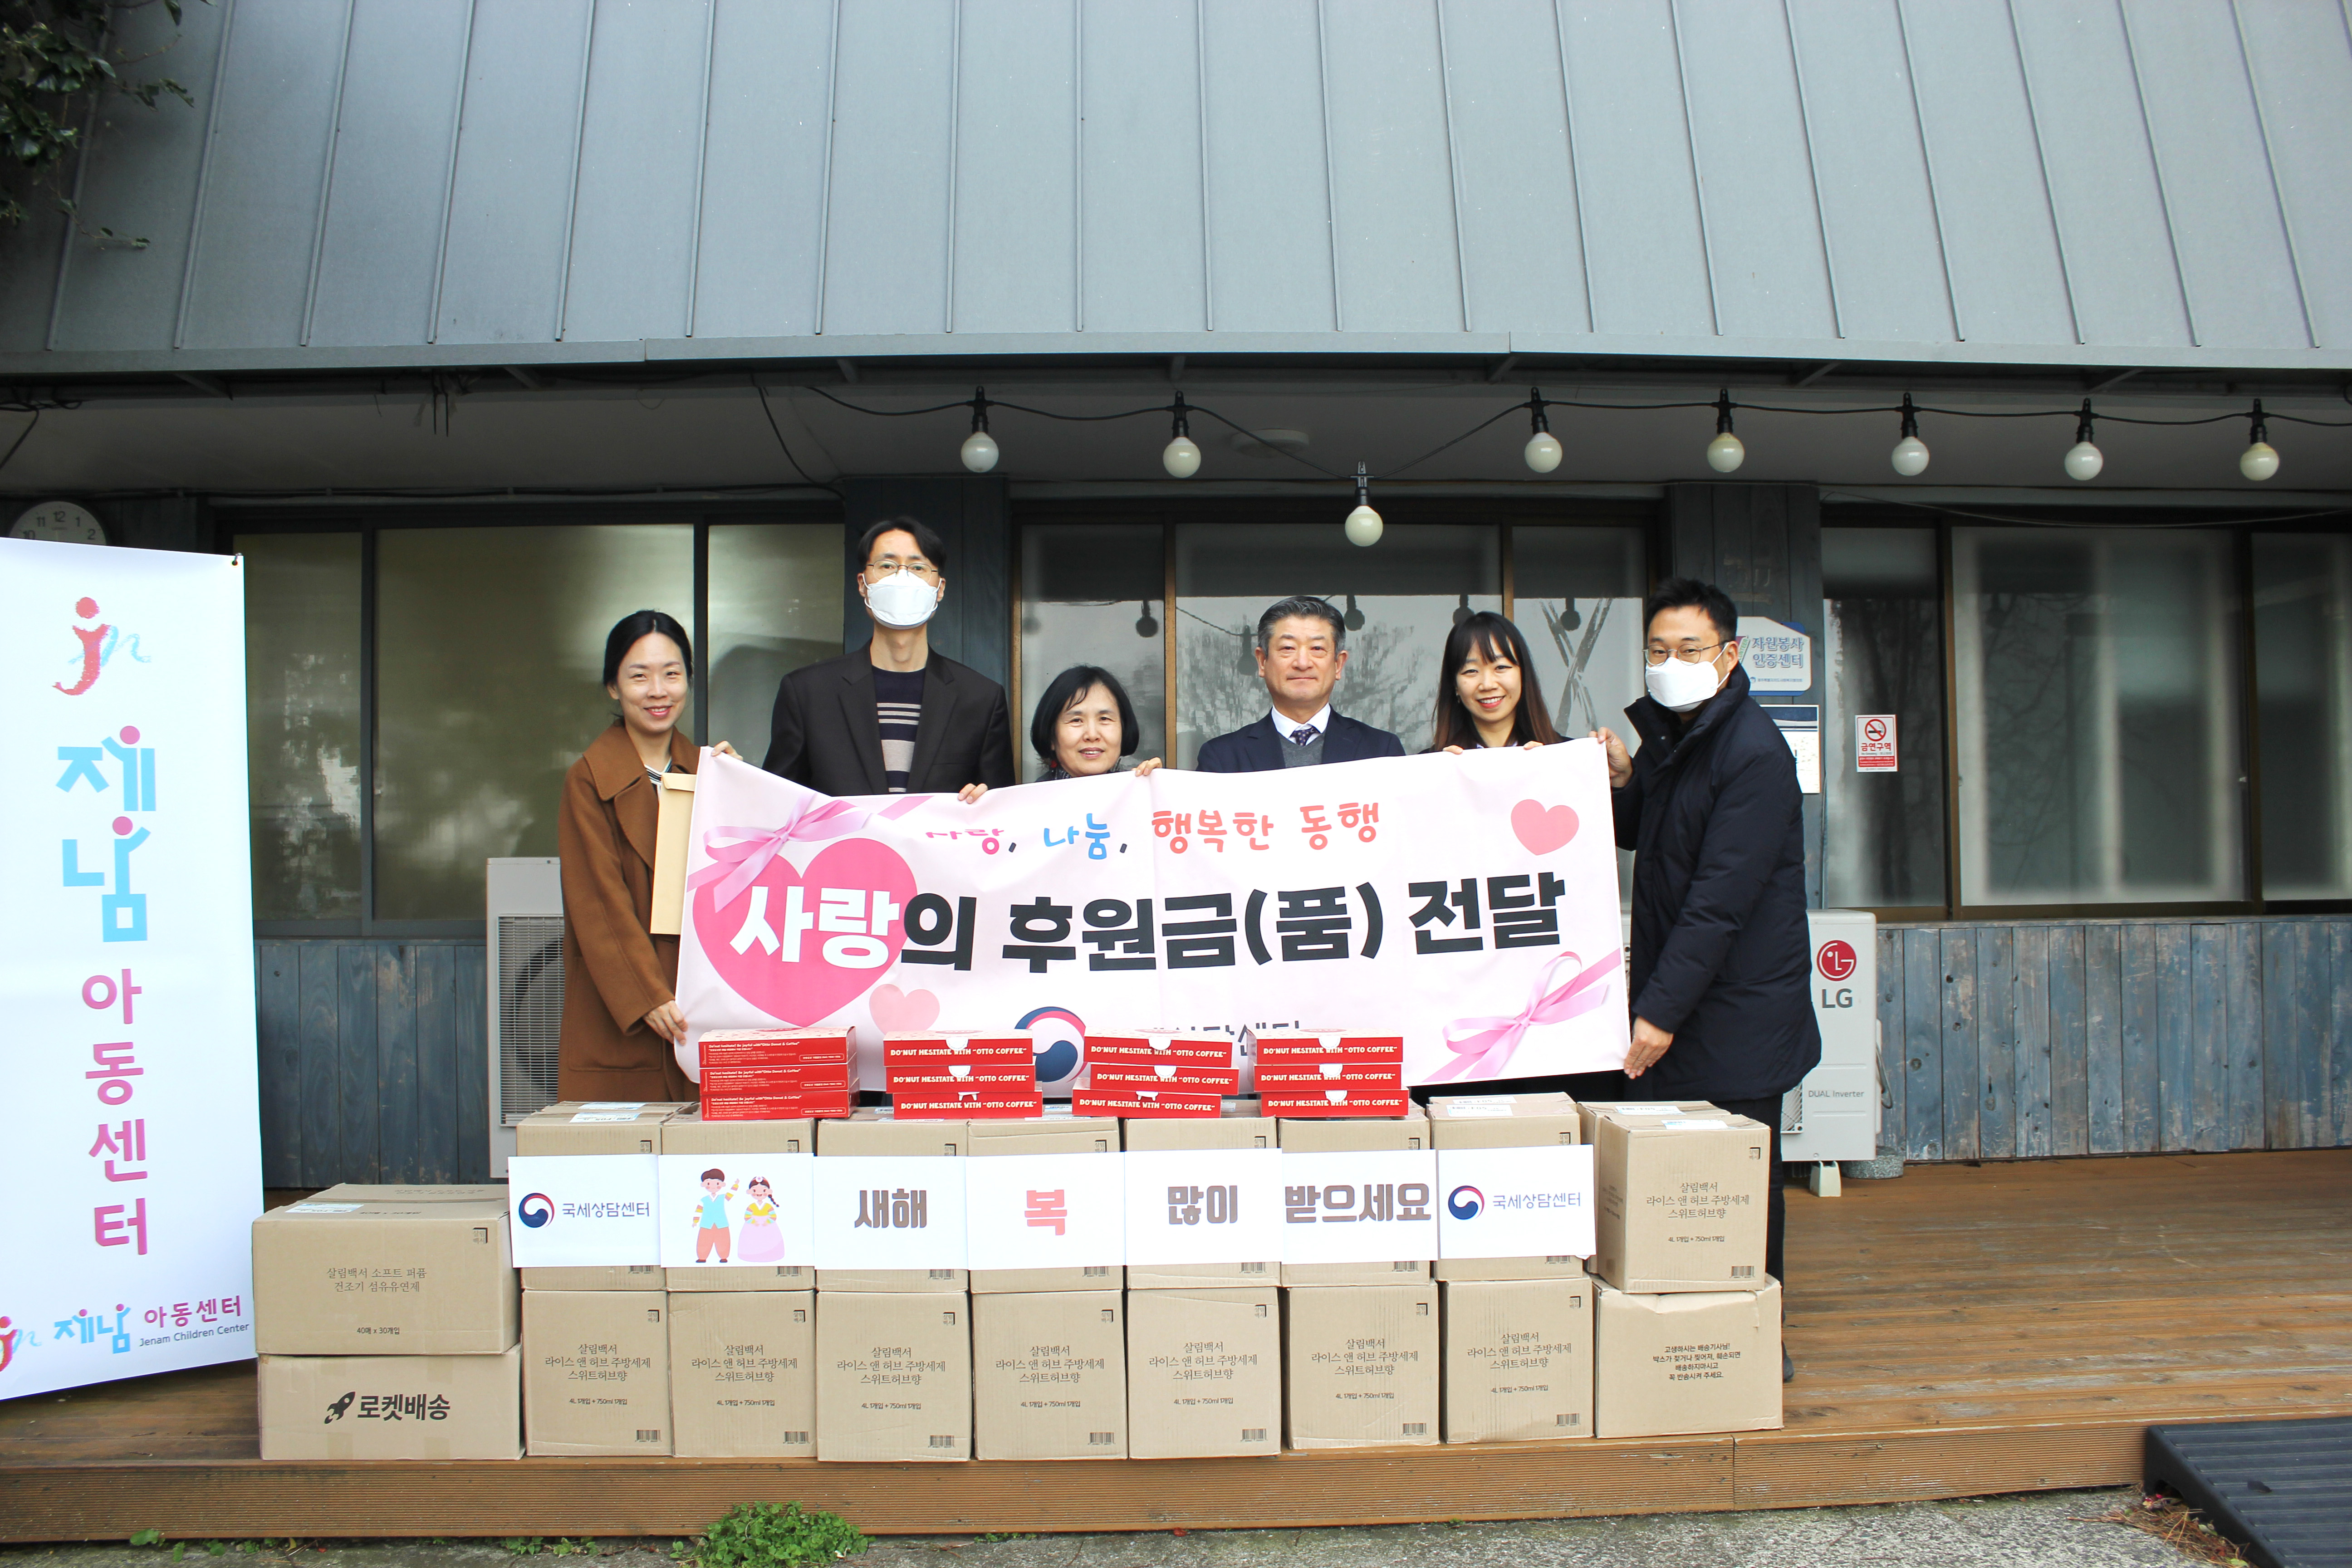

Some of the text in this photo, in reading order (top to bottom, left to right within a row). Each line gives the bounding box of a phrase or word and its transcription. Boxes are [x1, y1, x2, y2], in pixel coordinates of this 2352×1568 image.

[37, 516, 45, 527] 11
[53, 511, 65, 522] 12
[76, 517, 80, 527] 1
[88, 529, 96, 539] 2
[1752, 637, 1803, 651] 자원봉사
[1753, 654, 1803, 668] 인증센터
[1861, 743, 1891, 751] 금연구역
[1043, 813, 1128, 860] 나눔,
[1152, 808, 1274, 854] 행복한
[1300, 802, 1380, 850] 동행
[729, 871, 1565, 973] 사랑의 후원금(품) 전달
[56, 725, 156, 1255] 제남 아동센터
[1822, 989, 1853, 1009] LG
[1833, 1090, 1864, 1098] Inverter
[1679, 1181, 1718, 1194] 살림백서
[1492, 1192, 1581, 1210] 국세상담센터
[1646, 1194, 1749, 1206] 라이스 앤 허브 주방세제
[562, 1202, 650, 1218] 국세상담센터
[854, 1183, 1431, 1236] 새해 복 많이 받으세요
[1668, 1208, 1726, 1220] 스위트허브향
[326, 1267, 427, 1279] 살림백서 소프트 퍼퓸
[334, 1280, 420, 1293] 건조기 섬유유연제
[54, 1295, 241, 1354] 제남 아동센터
[357, 1326, 372, 1335] 40매
[379, 1326, 400, 1335] 30개입
[139, 1323, 249, 1347] Jenam Children Center
[1500, 1331, 1539, 1345] 살림백서
[578, 1343, 617, 1356] 살림백서
[724, 1344, 764, 1356] 살림백서
[1182, 1341, 1224, 1354] 살림백서
[1345, 1338, 1385, 1350] 살림백서
[1466, 1343, 1572, 1358] 라이스 앤 허브 주방세제
[1698, 1343, 1730, 1351] 배송기사님!
[871, 1346, 912, 1359] 살림백서
[1029, 1345, 1070, 1357] 살림백서
[1311, 1350, 1418, 1363] 라이스 앤 허브 주방세제
[1716, 1351, 1740, 1360] 훼손되면
[544, 1356, 651, 1369] 라이스 앤 허브 주방세제
[691, 1357, 798, 1369] 라이스 앤 허브 주방세제
[837, 1359, 946, 1373] 라이스 앤 허브 주방세제
[995, 1358, 1104, 1370] 라이스 앤 허브 주방세제
[1149, 1354, 1257, 1367] 라이스 앤 허브 주방세제
[1490, 1357, 1549, 1371] 스위트허브향
[1675, 1362, 1718, 1371] 배송하지마시고
[568, 1370, 627, 1382] 스위트허브향
[715, 1371, 774, 1382] 스위트허브향
[1172, 1368, 1234, 1381] 스위트허브향
[1334, 1364, 1395, 1376] 스위트허브향
[1677, 1372, 1701, 1381] 반송시켜
[860, 1373, 922, 1386] 스위트허브향
[1019, 1372, 1081, 1384] 스위트허브향
[358, 1393, 451, 1421] 로켓배송
[907, 1402, 921, 1410] 1개입
